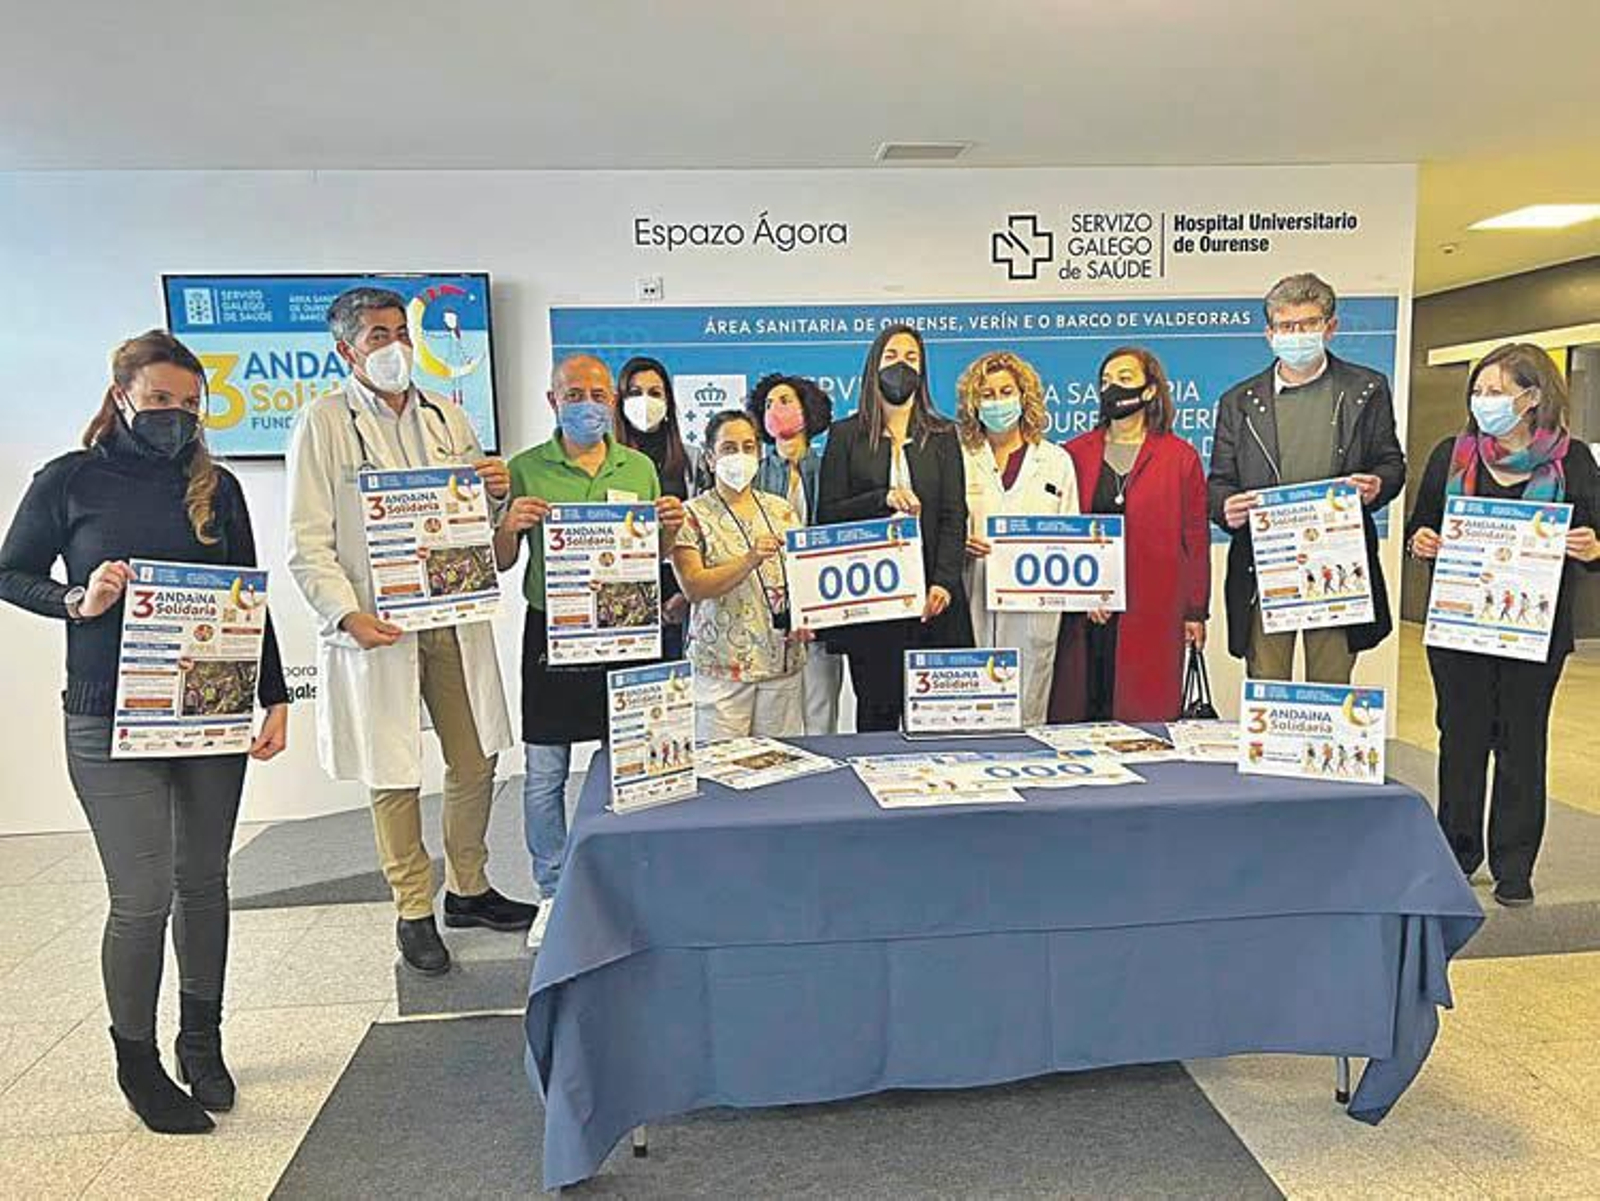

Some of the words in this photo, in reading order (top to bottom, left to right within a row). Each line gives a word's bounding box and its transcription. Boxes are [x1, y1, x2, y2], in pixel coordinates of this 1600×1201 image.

[635, 217, 744, 252] Espazo
[753, 210, 848, 252] Ágora
[1071, 213, 1152, 233] SERVIZO
[1174, 213, 1243, 235] Hospital
[1249, 212, 1357, 232] Universitario
[1067, 236, 1152, 256] GALEGO
[1173, 236, 1195, 253] de
[1199, 235, 1270, 253] Ourense
[1058, 260, 1081, 280] de
[1087, 256, 1151, 279] SAÚDE
[704, 316, 751, 334] ÁREA
[756, 318, 848, 334] SANITARIA
[853, 317, 875, 332] DE
[969, 311, 1019, 330] VERÍN
[1023, 314, 1034, 329] E
[1037, 314, 1051, 329] O
[1055, 313, 1112, 328] BARCO
[1116, 312, 1138, 327] DE
[1142, 310, 1252, 327] VALDEORRAS
[200, 354, 247, 430] 3
[244, 350, 347, 380] ANDA
[366, 496, 386, 520] 3
[1253, 512, 1271, 532] 3
[1446, 519, 1464, 540] 3
[549, 528, 566, 551] 3
[818, 558, 899, 601] 000
[1015, 553, 1099, 587] 000
[131, 590, 155, 619] 3
[155, 601, 218, 617] Solidaria
[916, 671, 931, 693] 3
[1248, 707, 1268, 734] 3
[1269, 719, 1334, 733] Solidaria
